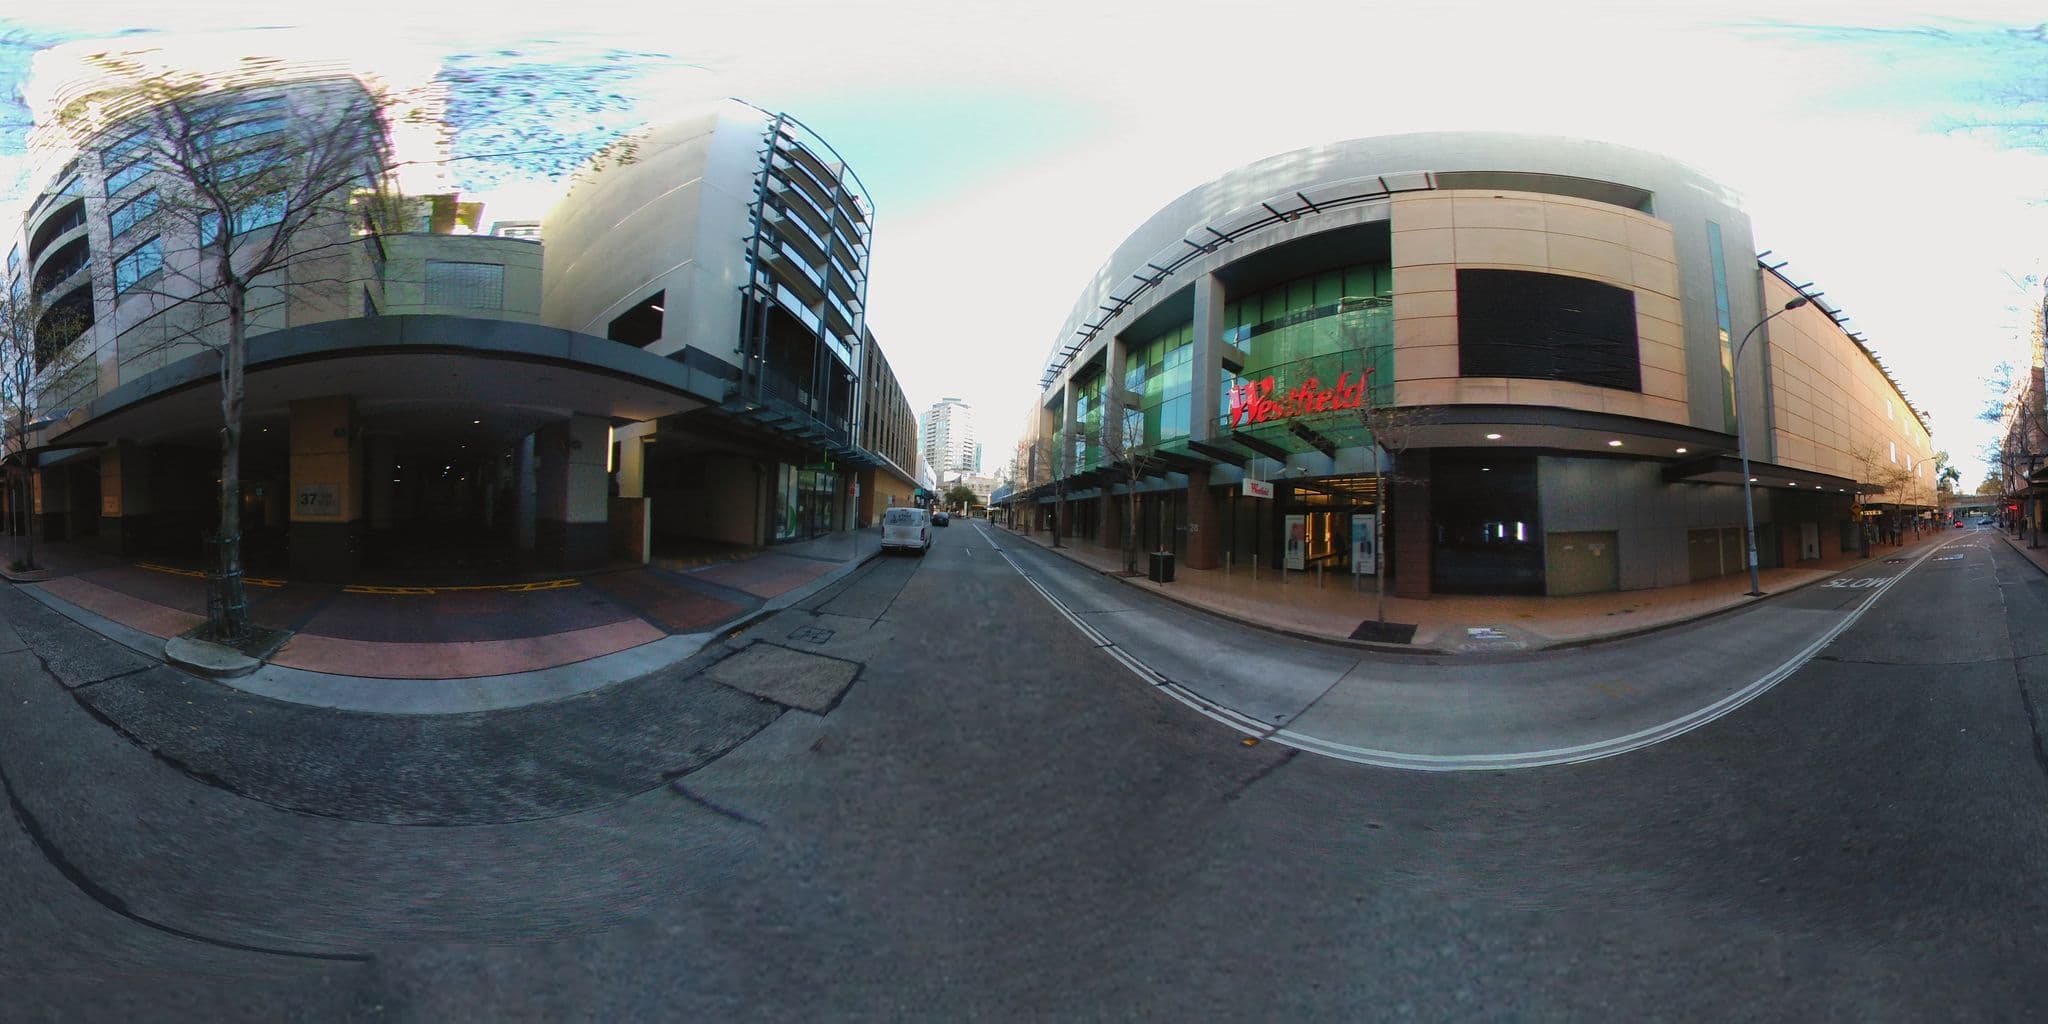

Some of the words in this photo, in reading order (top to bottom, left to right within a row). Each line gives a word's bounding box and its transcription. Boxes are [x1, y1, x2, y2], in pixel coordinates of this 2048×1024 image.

[1229, 368, 1375, 428] Westfield
[300, 493, 317, 504] 37
[1820, 577, 1893, 588] SLOW
